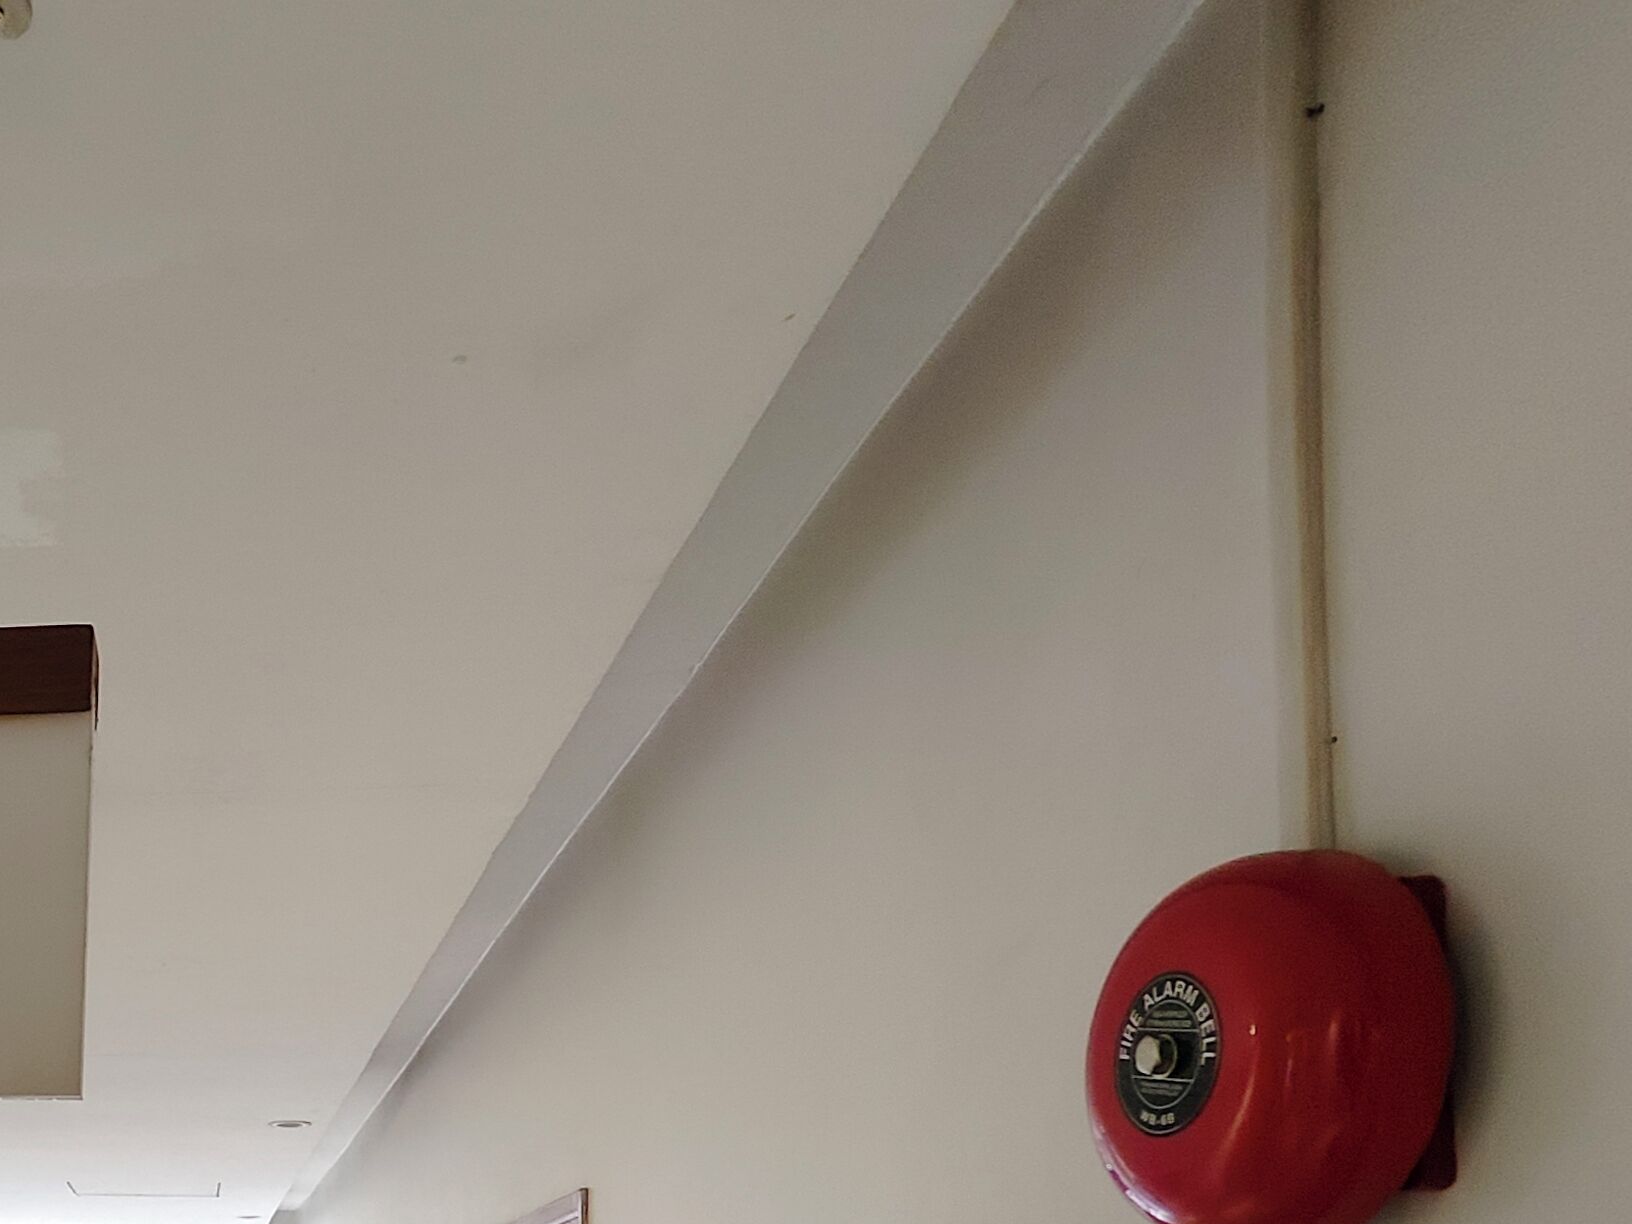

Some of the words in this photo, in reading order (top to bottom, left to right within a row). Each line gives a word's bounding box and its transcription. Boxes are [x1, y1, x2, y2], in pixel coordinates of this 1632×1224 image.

[1119, 1009, 1144, 1061] FIRE
[1142, 980, 1199, 1011] ALARM
[1194, 1002, 1217, 1066] BELL
